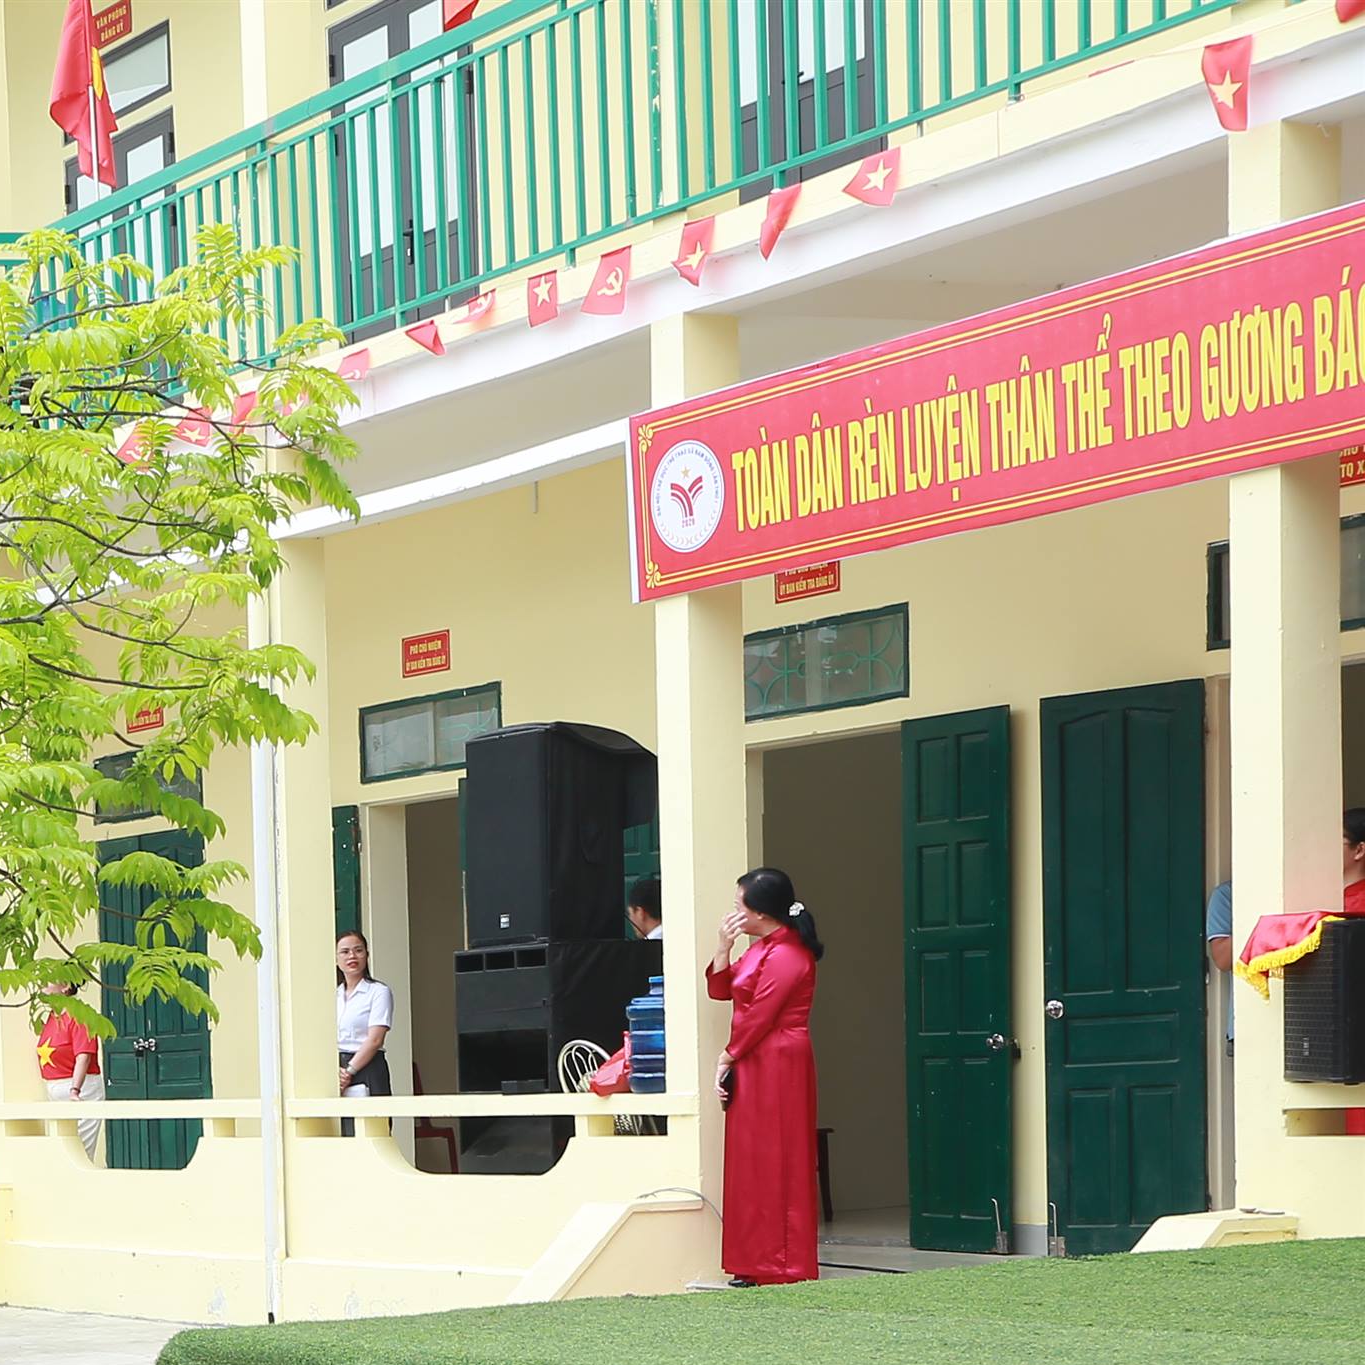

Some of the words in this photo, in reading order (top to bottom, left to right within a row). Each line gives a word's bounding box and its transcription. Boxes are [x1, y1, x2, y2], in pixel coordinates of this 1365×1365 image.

[730, 426, 791, 532] TOÀN
[794, 412, 844, 518] DÂN
[847, 398, 897, 505] RÈN
[901, 374, 982, 502] LUYỆN
[985, 354, 1056, 472] THÂN
[1061, 312, 1114, 455] THỂ
[1118, 331, 1191, 440] THEO
[1200, 302, 1305, 422] GƯƠNG
